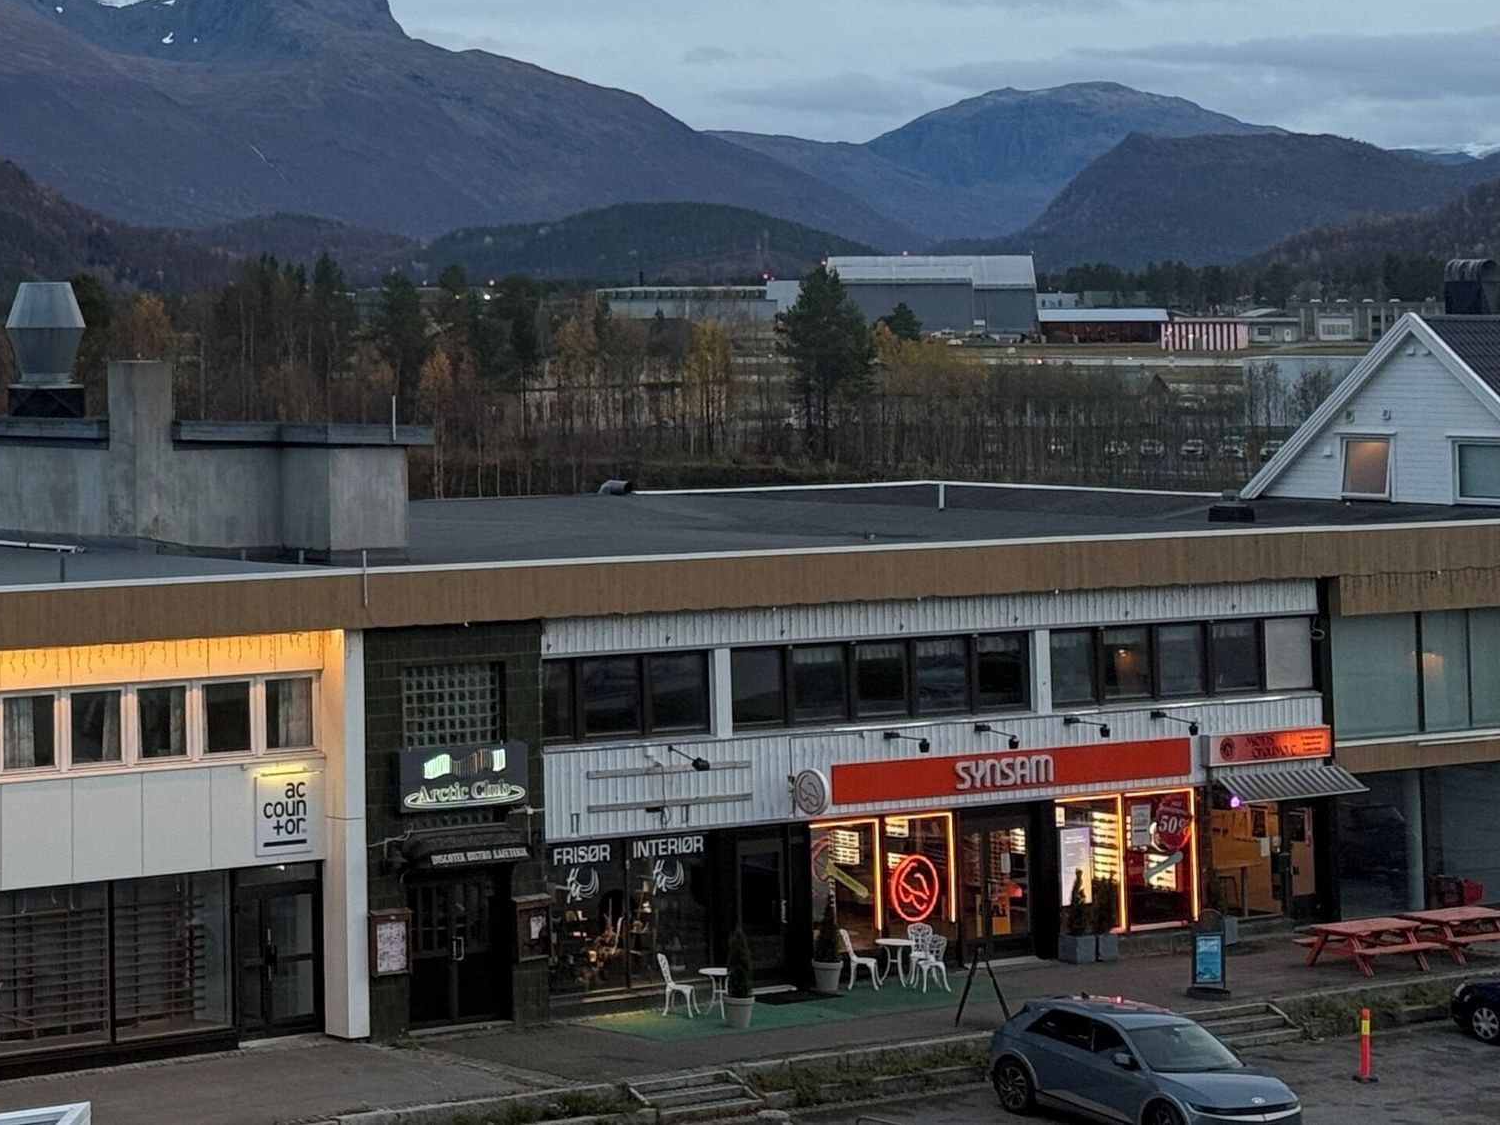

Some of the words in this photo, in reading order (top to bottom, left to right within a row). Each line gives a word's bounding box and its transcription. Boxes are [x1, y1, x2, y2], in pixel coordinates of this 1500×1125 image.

[955, 755, 1054, 789] SYNSAM
[419, 782, 469, 802] Arctic
[471, 779, 511, 799] Club
[263, 799, 307, 819] coun
[553, 844, 611, 866] FRISØR
[633, 836, 704, 859] INTERIØR
